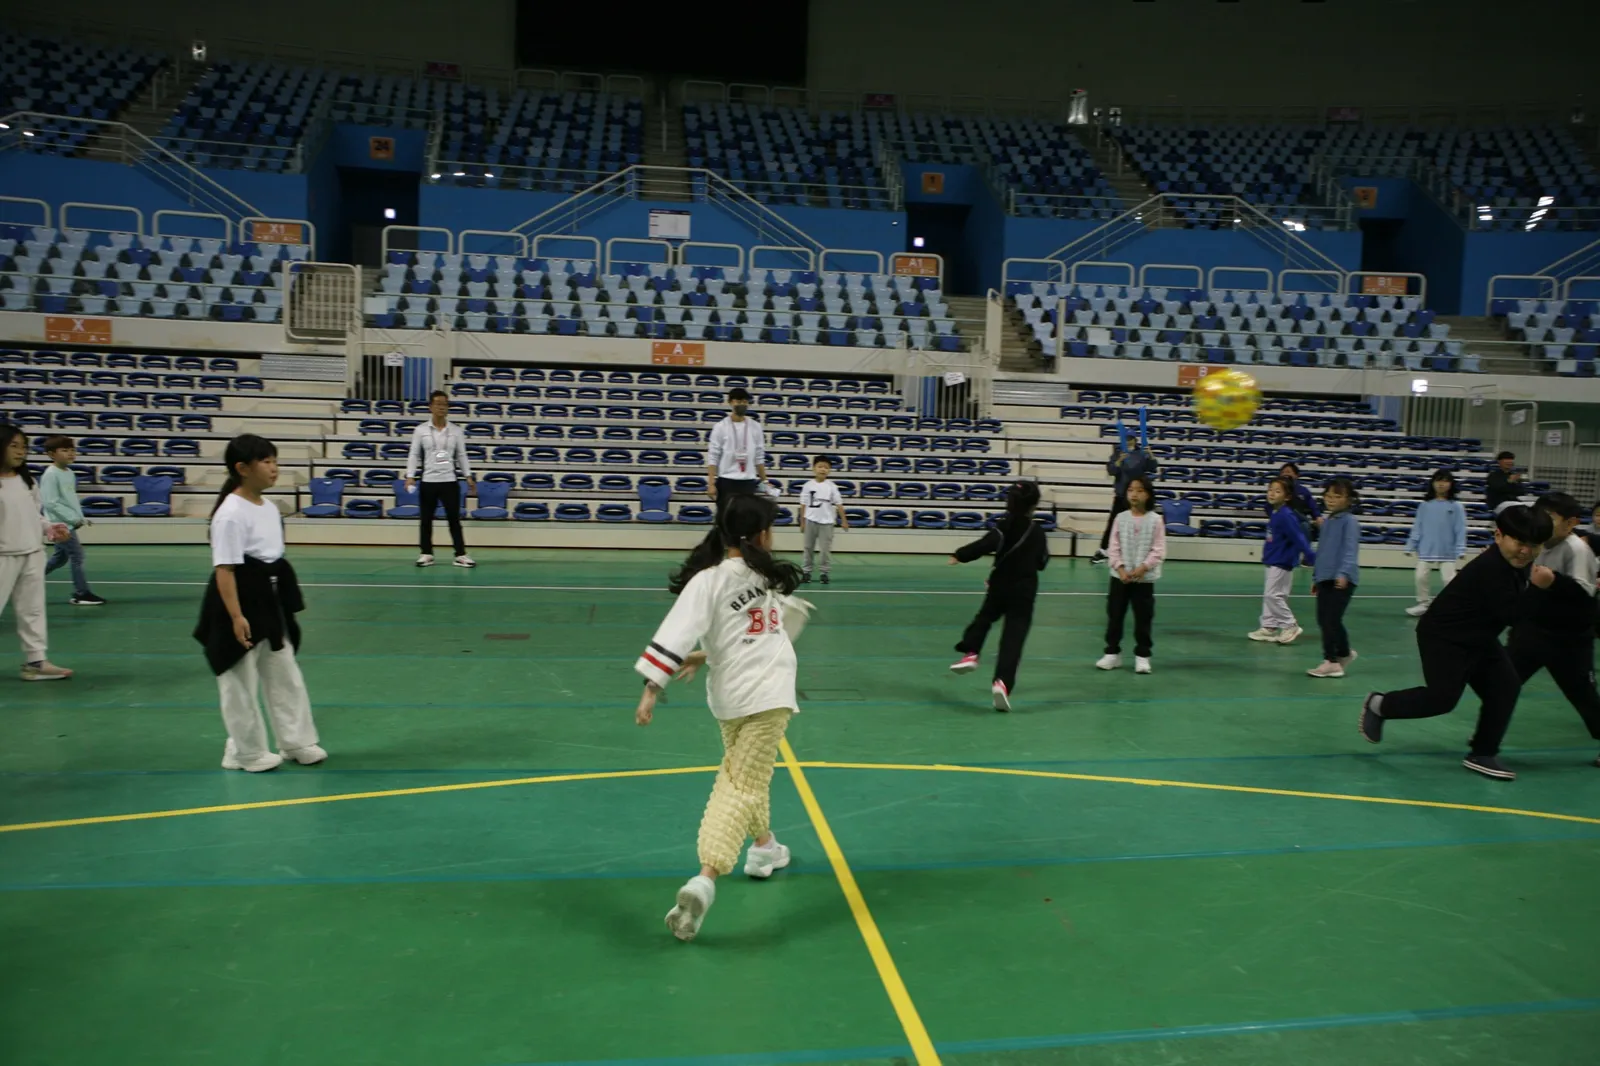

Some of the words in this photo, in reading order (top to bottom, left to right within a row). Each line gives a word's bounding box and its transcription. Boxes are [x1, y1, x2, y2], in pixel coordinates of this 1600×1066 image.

[269, 223, 285, 234] X1
[908, 257, 923, 268] A1
[71, 318, 85, 332] X
[672, 343, 684, 355] A
[1199, 366, 1208, 377] B
